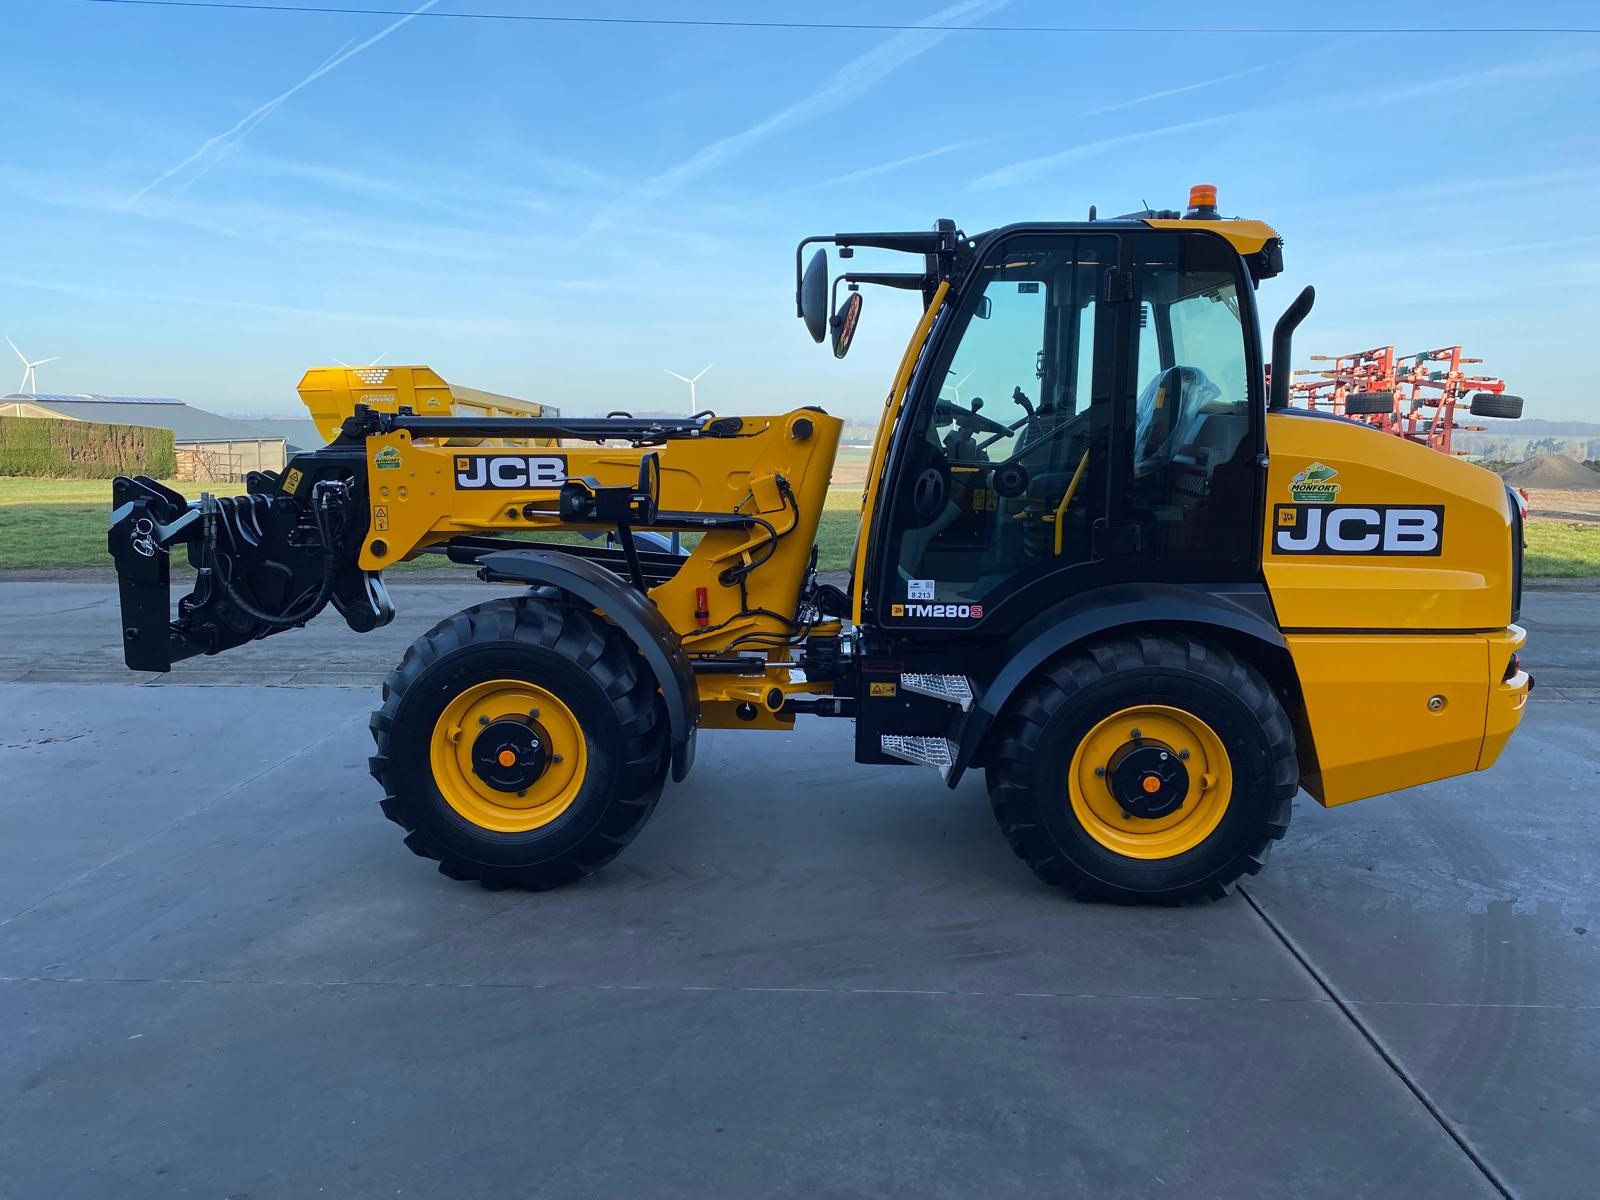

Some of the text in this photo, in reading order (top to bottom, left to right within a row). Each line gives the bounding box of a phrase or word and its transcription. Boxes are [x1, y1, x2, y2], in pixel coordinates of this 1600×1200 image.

[457, 457, 566, 487] JCB
[1277, 508, 1439, 551] JCB
[905, 604, 983, 618] TM280S
